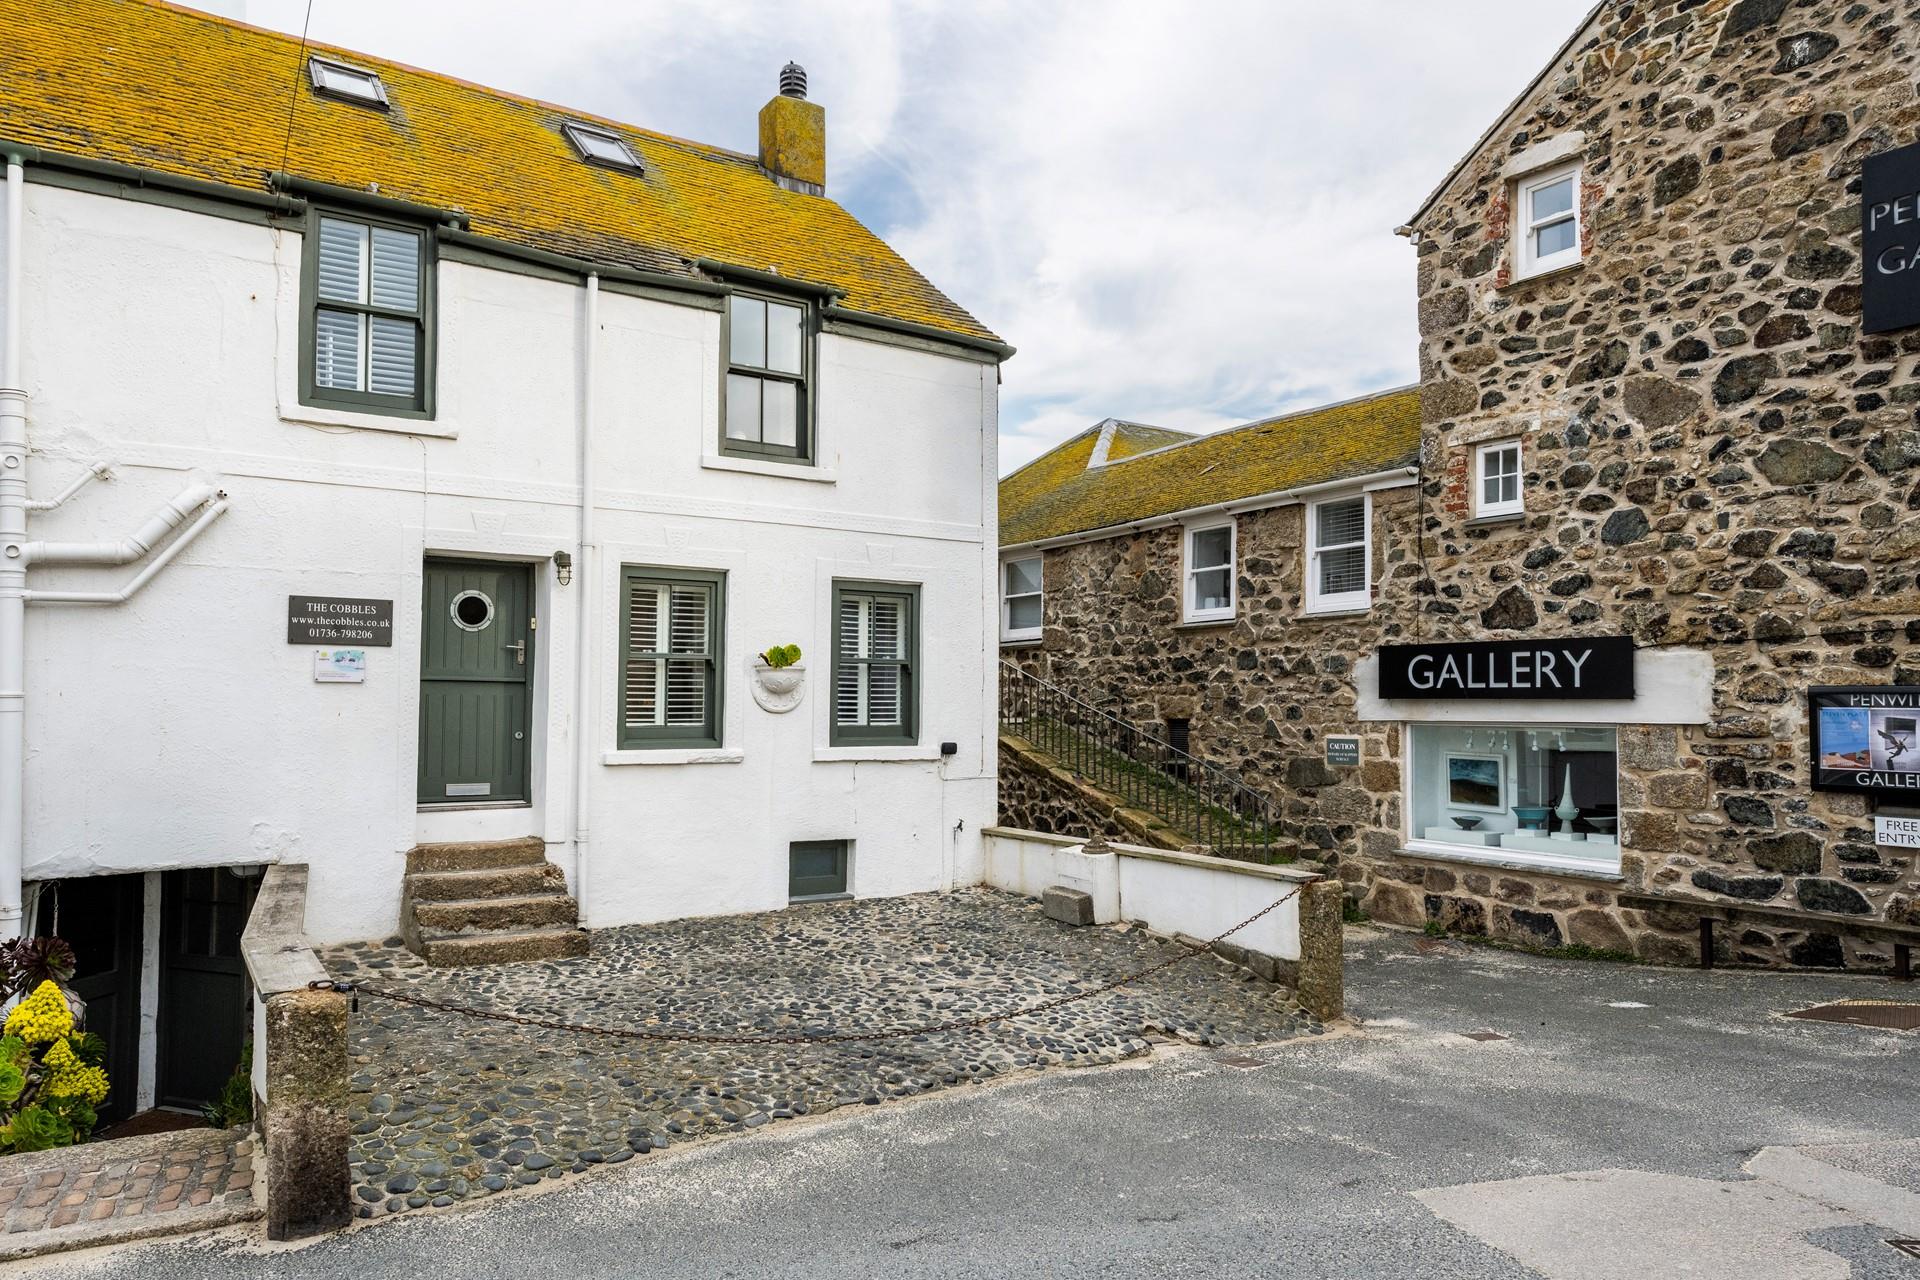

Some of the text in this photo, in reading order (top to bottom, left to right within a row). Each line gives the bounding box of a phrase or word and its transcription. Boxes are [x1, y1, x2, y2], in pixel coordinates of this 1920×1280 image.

[1870, 191, 1920, 232] PE
[306, 602, 377, 615] THE COBBLES
[291, 616, 390, 628] www.thecobbles.co.uk
[309, 628, 373, 639] 01736-798206
[1407, 649, 1593, 690] GALLERY
[1850, 693, 1920, 707] PENWI
[1329, 742, 1356, 750] CAUTION
[1855, 771, 1920, 788] GALLE
[1886, 820, 1918, 832] FREE
